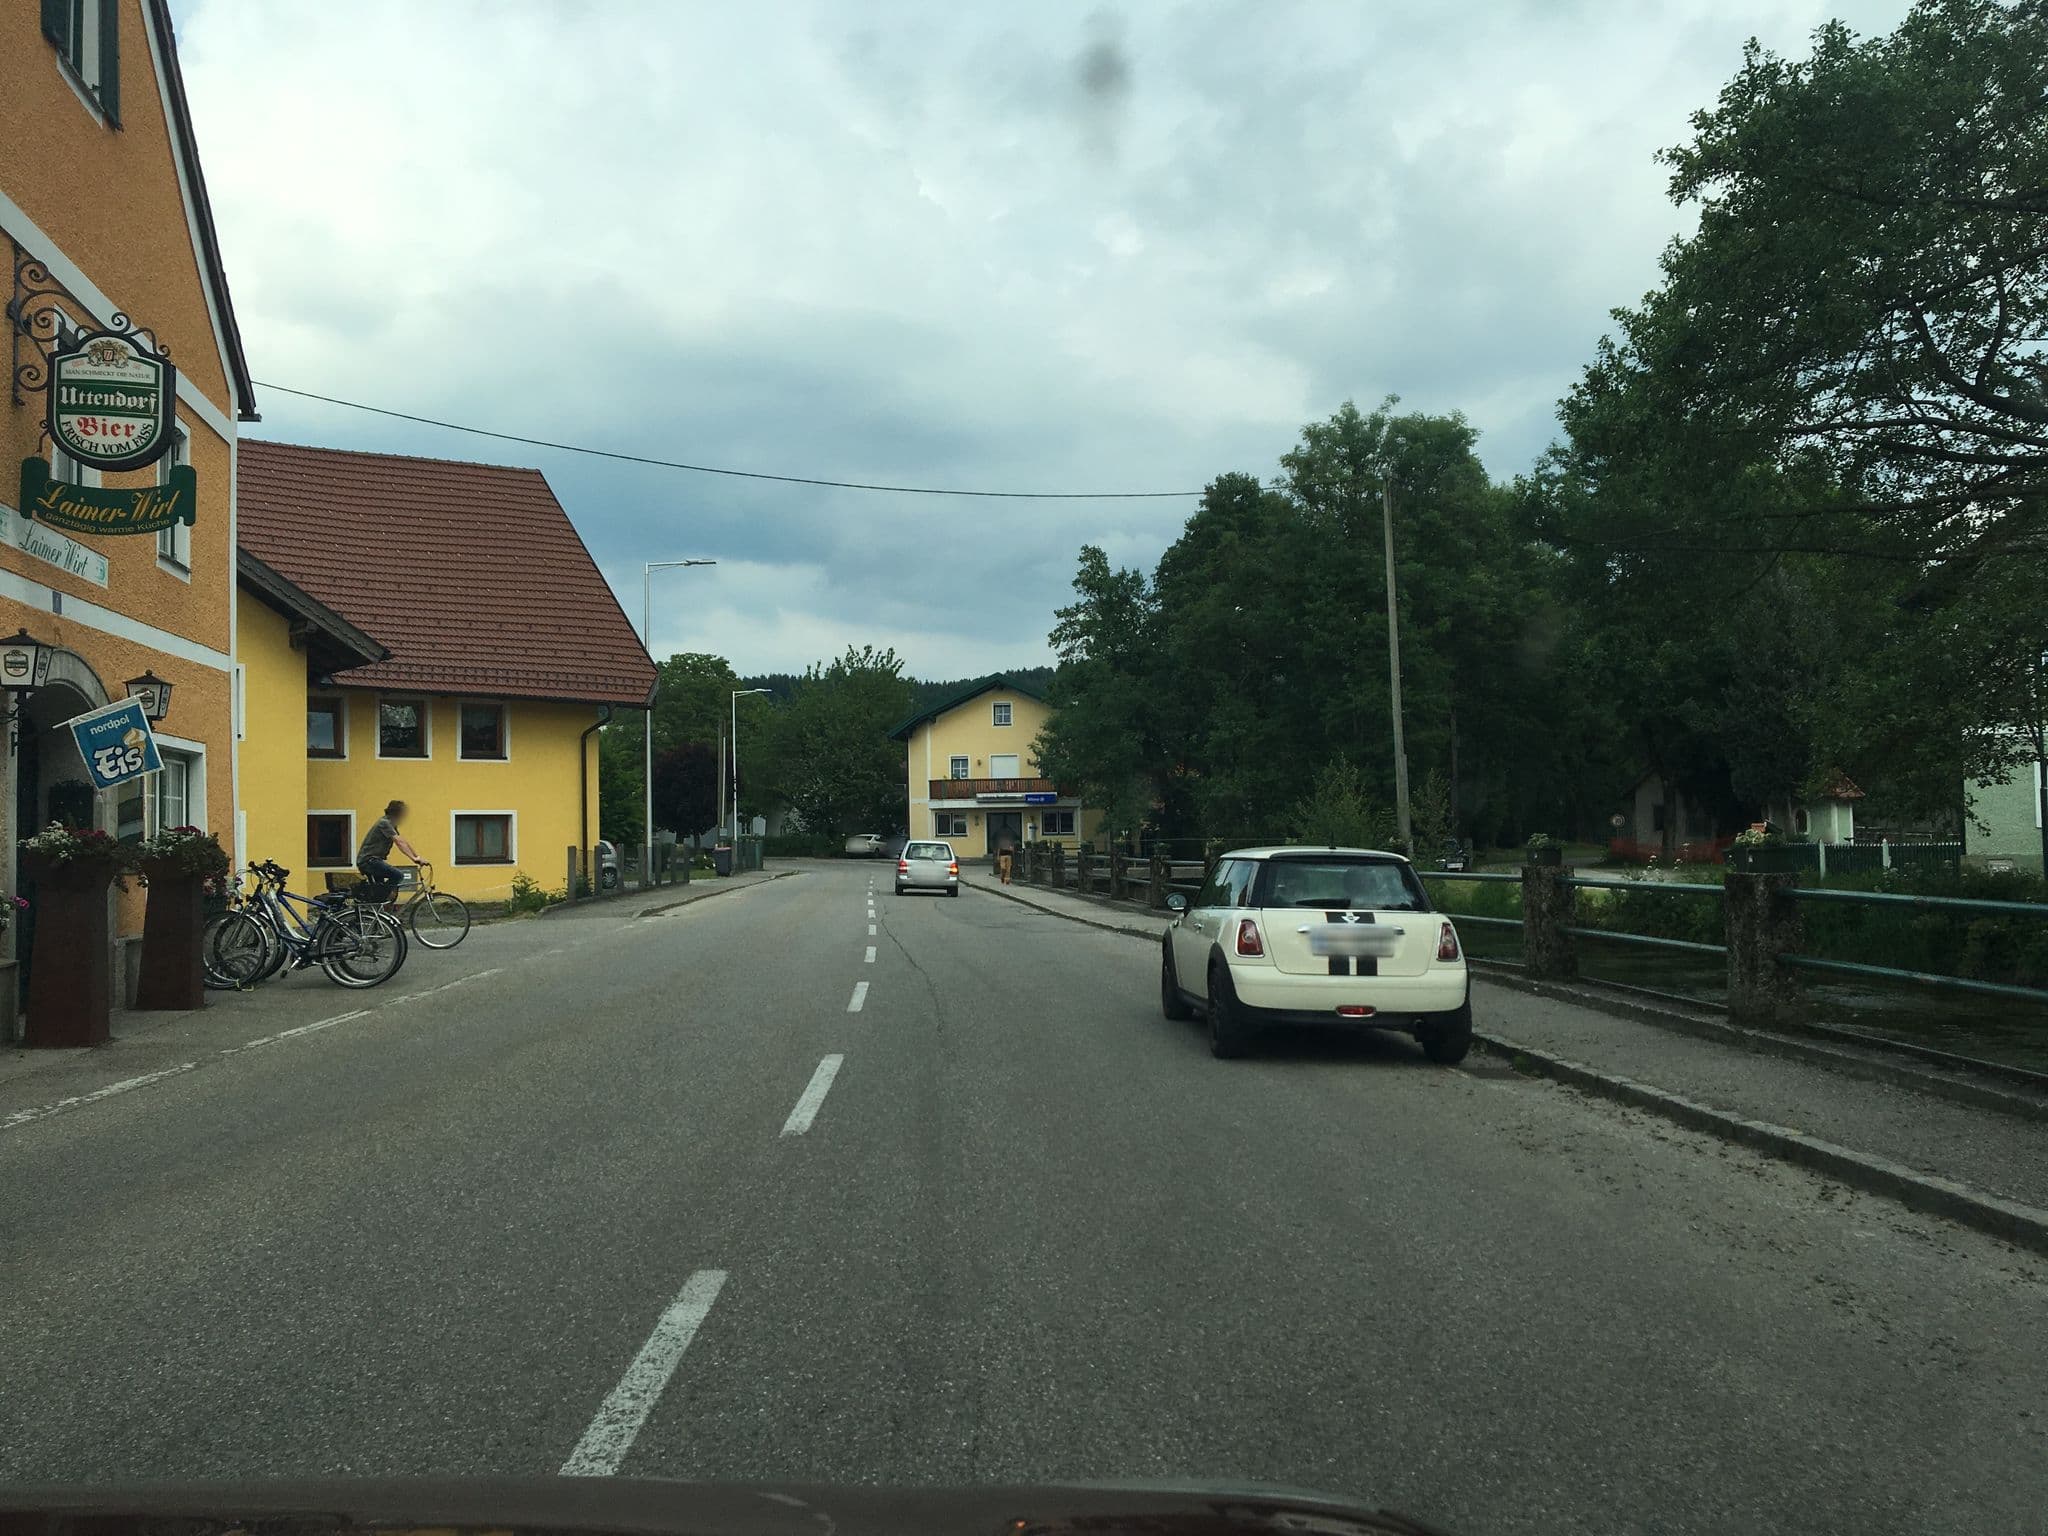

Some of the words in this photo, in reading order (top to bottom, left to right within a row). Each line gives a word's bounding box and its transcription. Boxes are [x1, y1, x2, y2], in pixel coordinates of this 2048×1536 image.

[60, 386, 157, 415] Uttendorf
[61, 420, 100, 453] FRISCH
[102, 441, 132, 454] VOM
[132, 423, 153, 448] FASS
[77, 416, 136, 438] Bier
[99, 525, 135, 534] warme
[137, 518, 170, 531] Küche
[19, 522, 62, 564] Laimer
[64, 540, 89, 577] Wirt
[89, 714, 130, 735] nordpol
[93, 745, 143, 779] Eis
